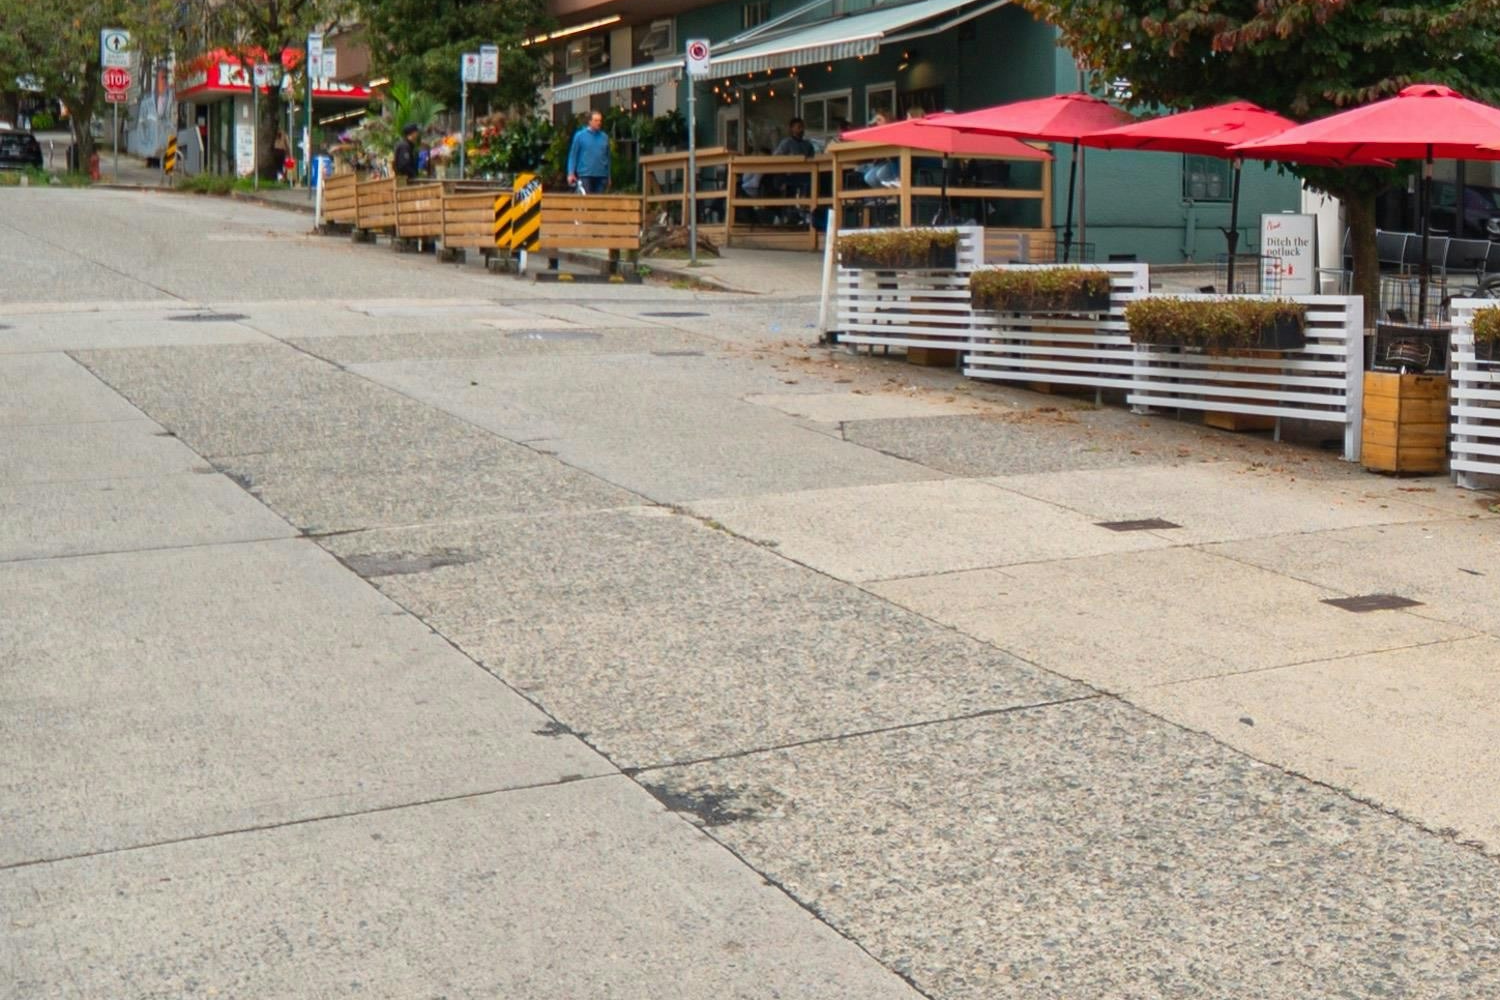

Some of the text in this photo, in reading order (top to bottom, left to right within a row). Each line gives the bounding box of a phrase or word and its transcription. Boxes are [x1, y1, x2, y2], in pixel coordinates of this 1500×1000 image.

[103, 73, 130, 86] STOP
[1267, 237, 1309, 247] Ditch the
[1266, 247, 1301, 258] potluck
